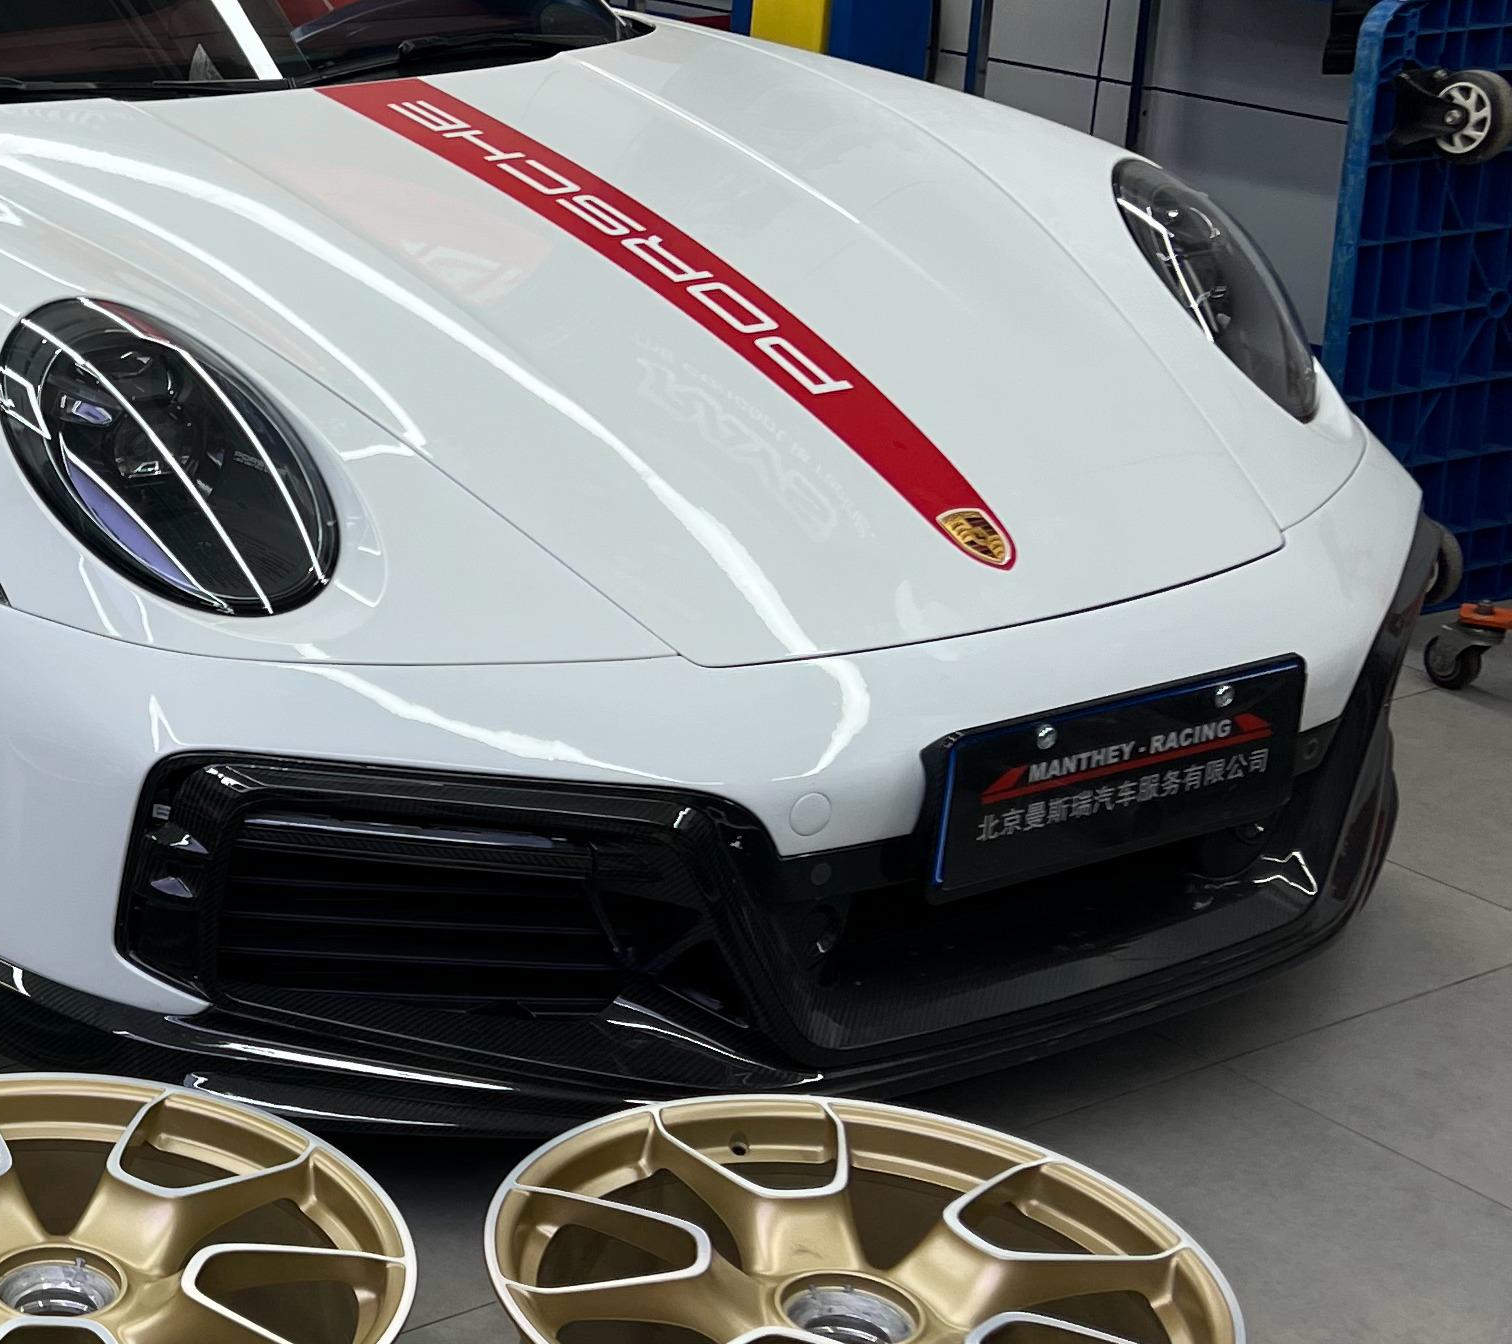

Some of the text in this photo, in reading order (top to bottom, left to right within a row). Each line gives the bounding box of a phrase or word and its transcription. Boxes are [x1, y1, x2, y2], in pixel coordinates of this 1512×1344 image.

[387, 100, 853, 395] PORSCHE
[976, 747, 1270, 842] 北京曼斯瑞汽车服务有限公司
[1028, 740, 1135, 783] MANTHEY
[1150, 718, 1233, 754] RACING
